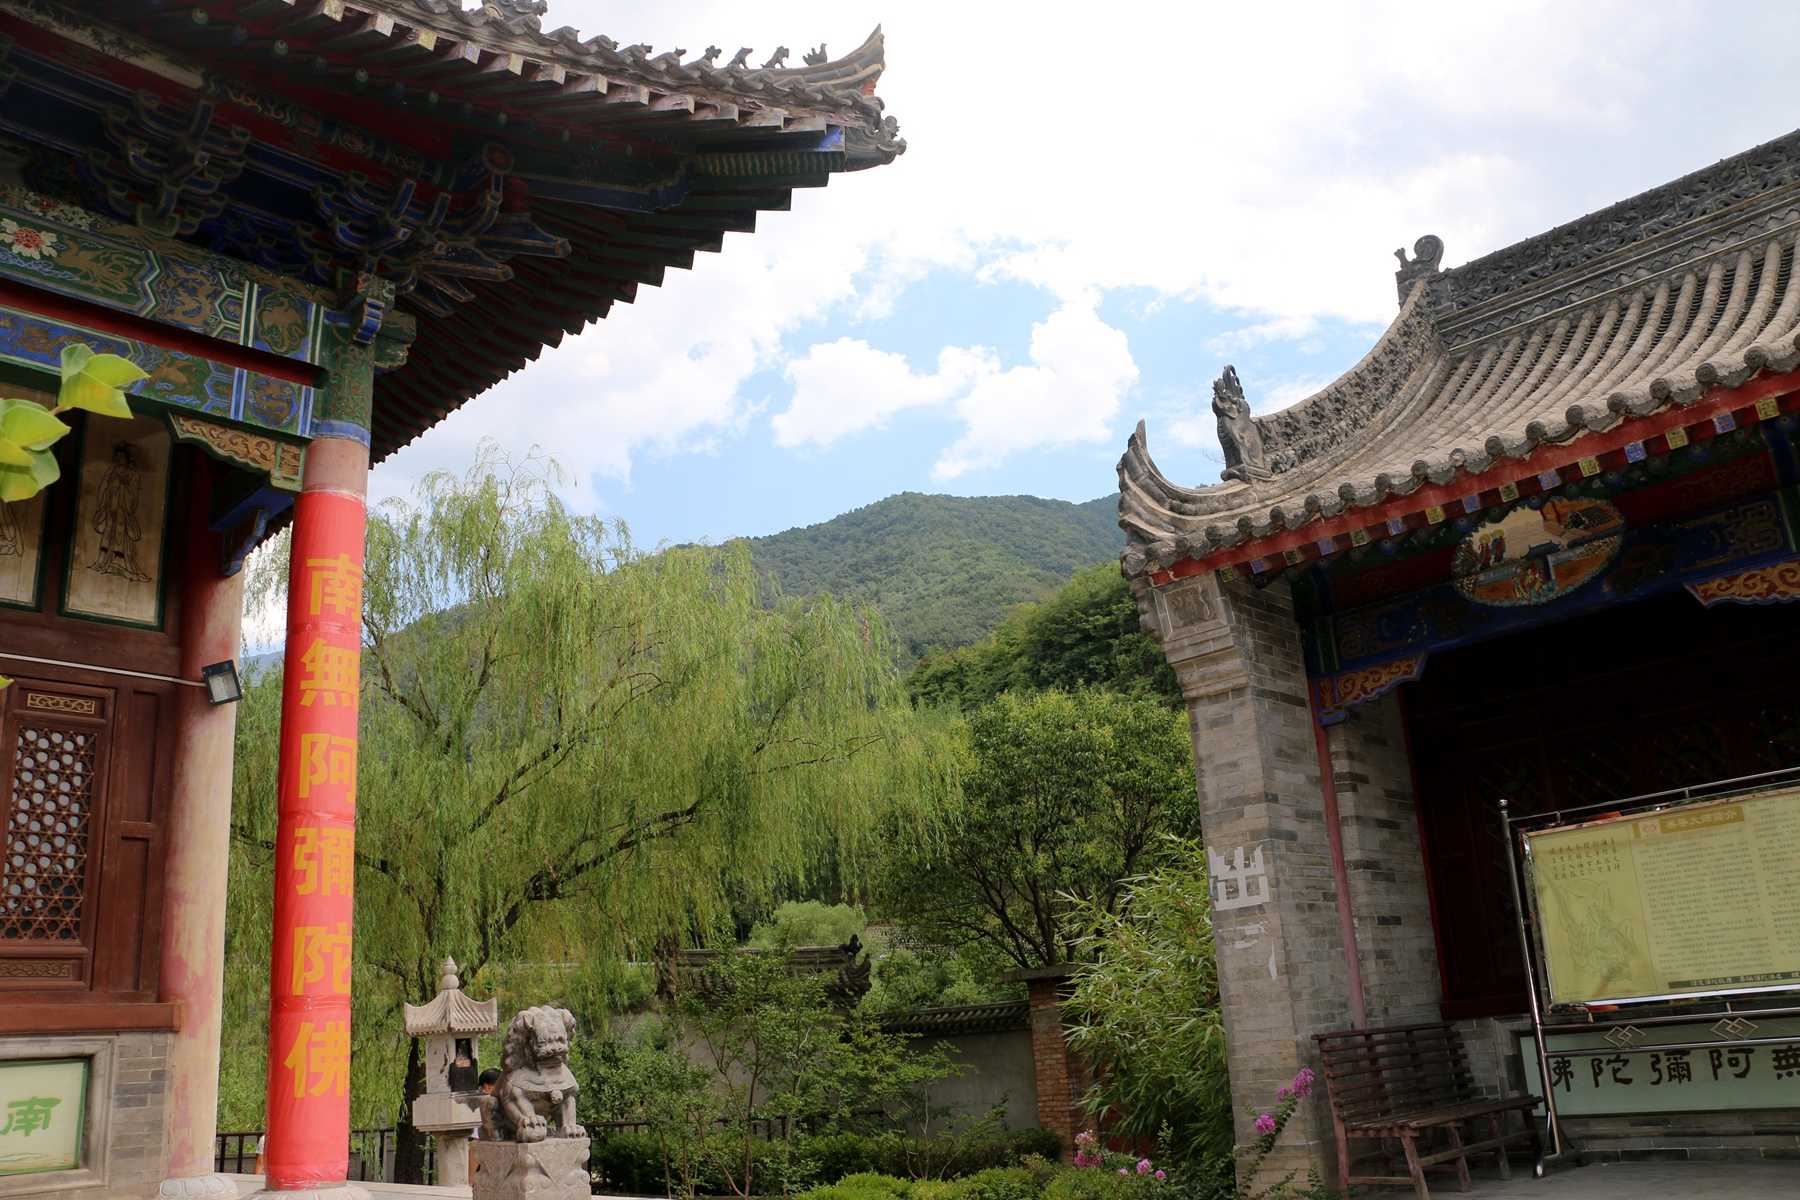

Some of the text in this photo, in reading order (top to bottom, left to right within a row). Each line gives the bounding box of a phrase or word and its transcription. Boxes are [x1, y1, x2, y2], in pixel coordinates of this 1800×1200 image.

[1665, 810, 1737, 829] 善导大师简介
[0, 1096, 62, 1137] 南
